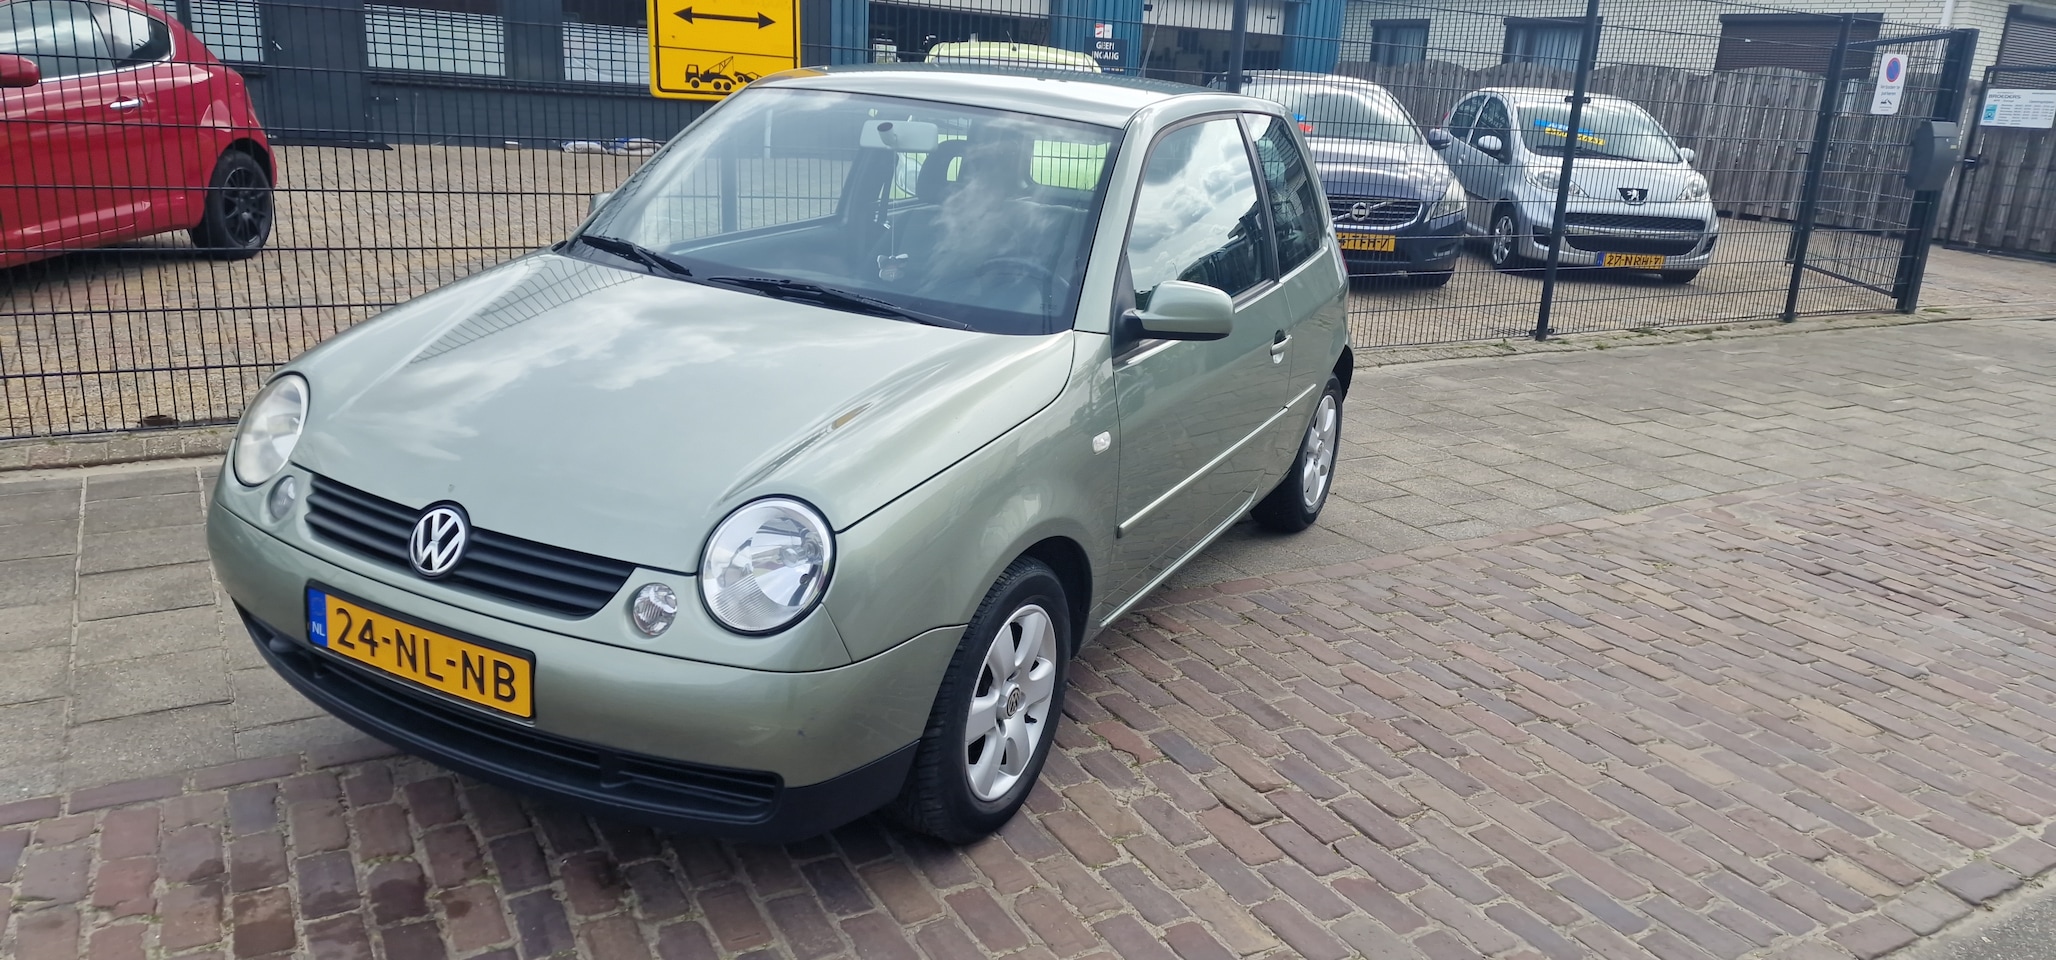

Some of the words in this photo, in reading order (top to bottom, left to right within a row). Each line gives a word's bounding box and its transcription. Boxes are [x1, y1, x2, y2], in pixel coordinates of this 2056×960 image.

[1095, 41, 1115, 50] GEEN
[1092, 51, 1119, 60] INGANG
[311, 620, 326, 637] NL
[335, 607, 517, 703] 24-NL-NB
